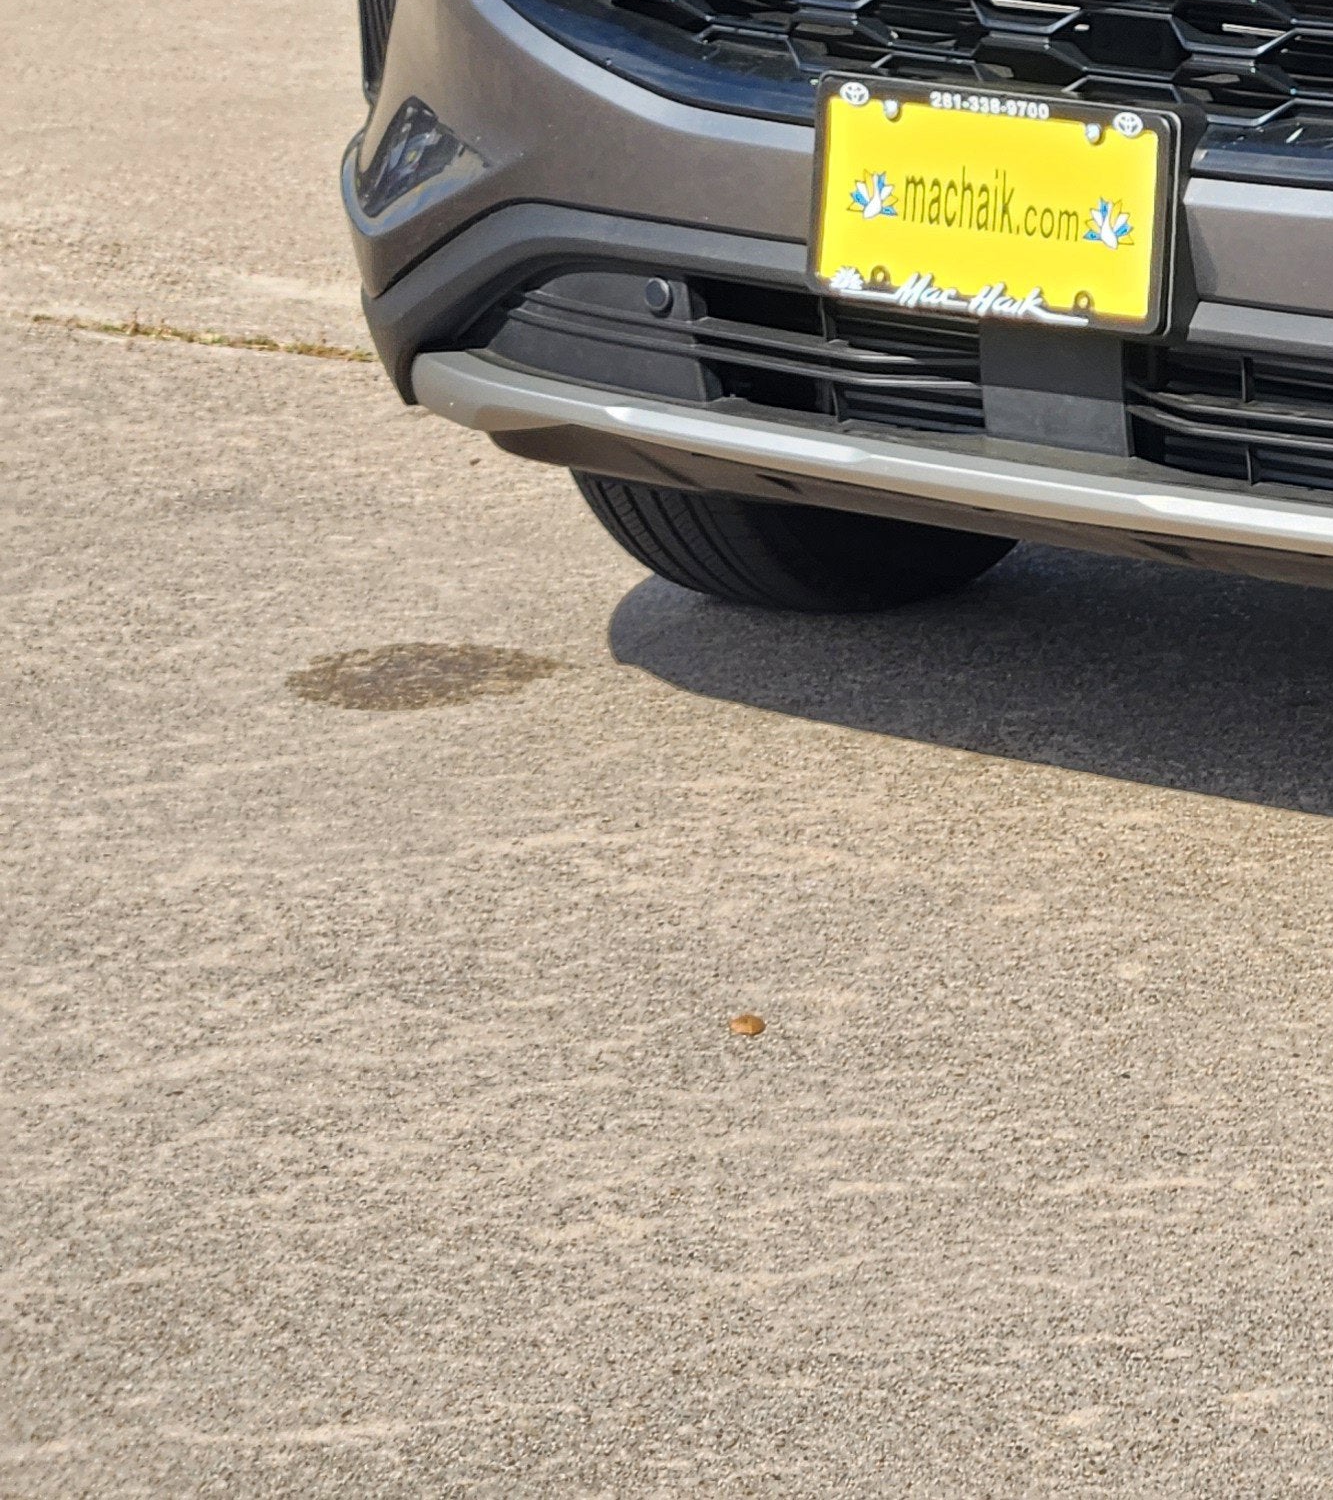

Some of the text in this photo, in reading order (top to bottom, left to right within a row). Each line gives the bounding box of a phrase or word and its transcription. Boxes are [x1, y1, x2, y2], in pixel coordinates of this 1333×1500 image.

[902, 165, 1080, 242] machaik.com
[895, 272, 1070, 322] Mac Haik
